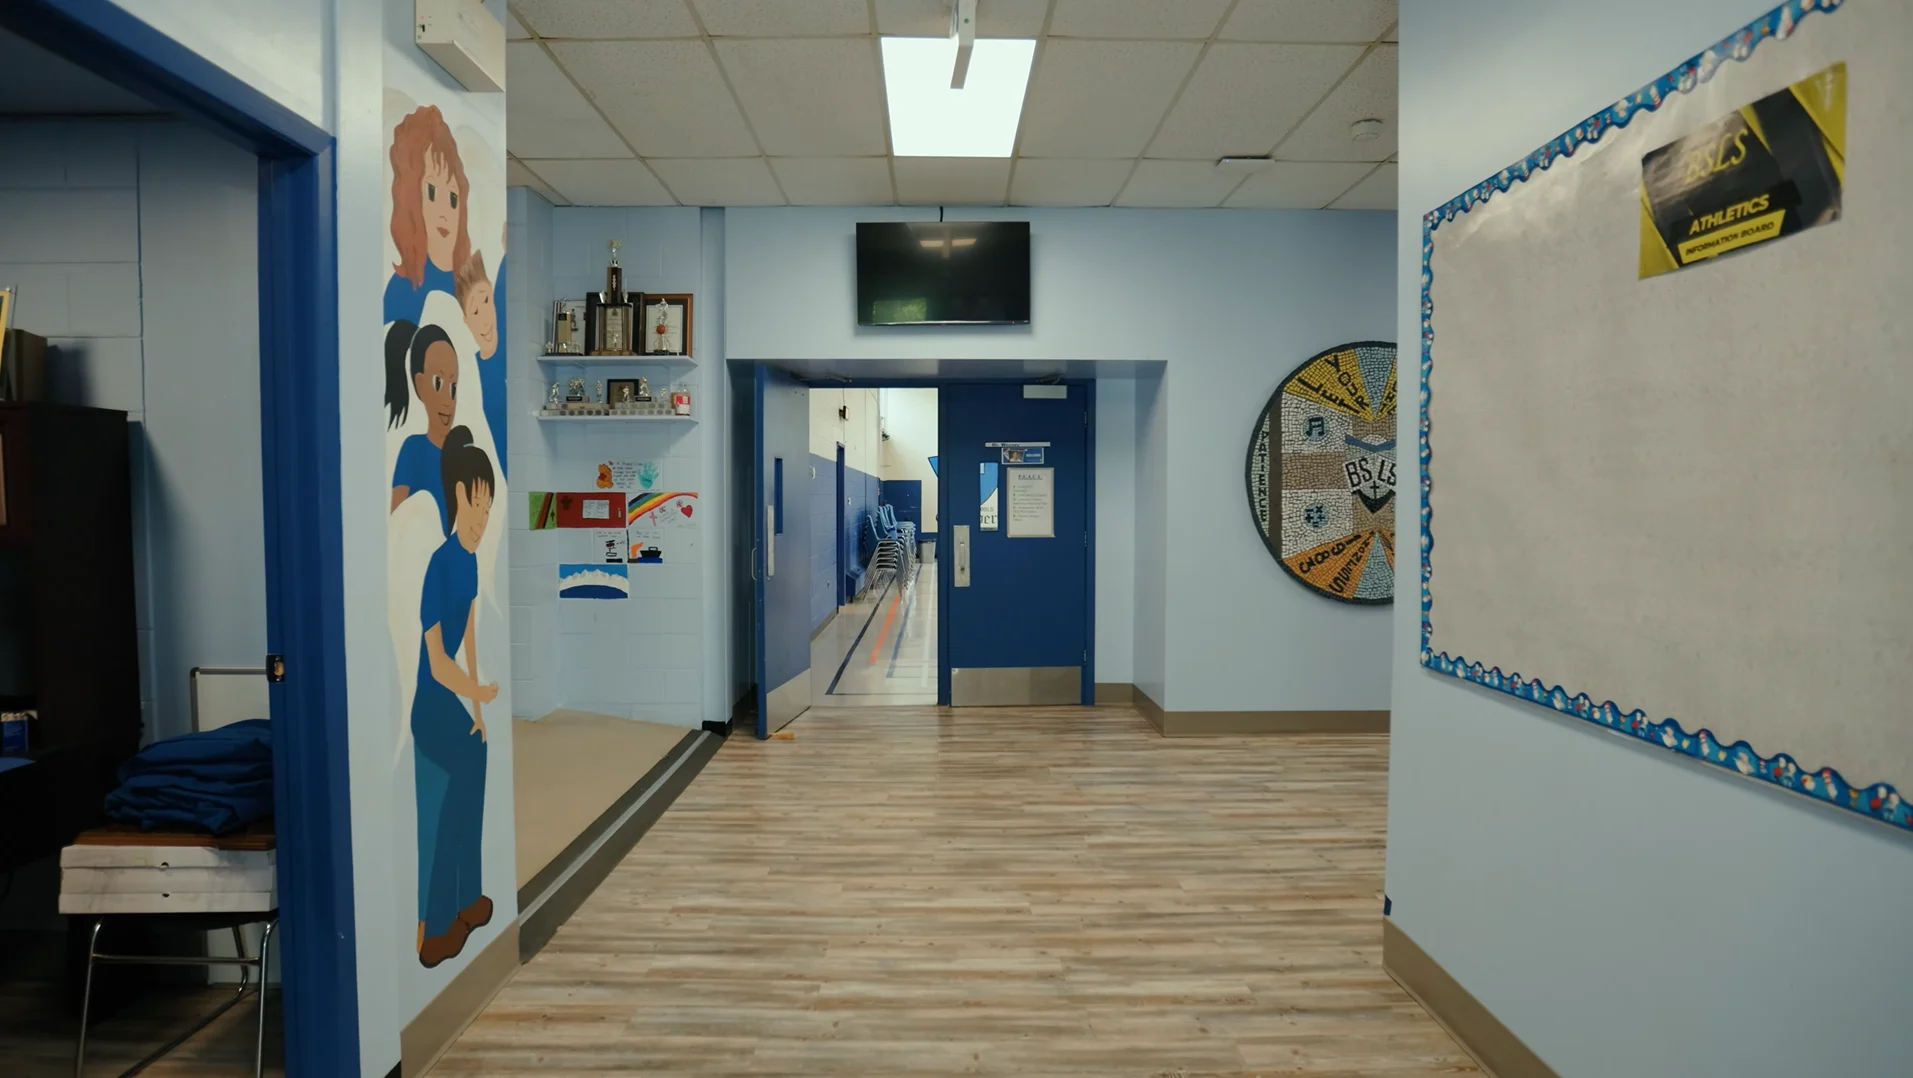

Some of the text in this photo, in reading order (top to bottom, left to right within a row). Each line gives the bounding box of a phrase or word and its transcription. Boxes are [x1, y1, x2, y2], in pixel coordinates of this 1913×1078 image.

[1684, 127, 1749, 184] BSLS
[1685, 220, 1775, 256] INFORMATION BOARD
[1689, 194, 1770, 236] ATHLETICS
[1325, 354, 1370, 411] YOUR
[1258, 431, 1269, 522] PATIENCE
[1345, 457, 1397, 487] BSLS
